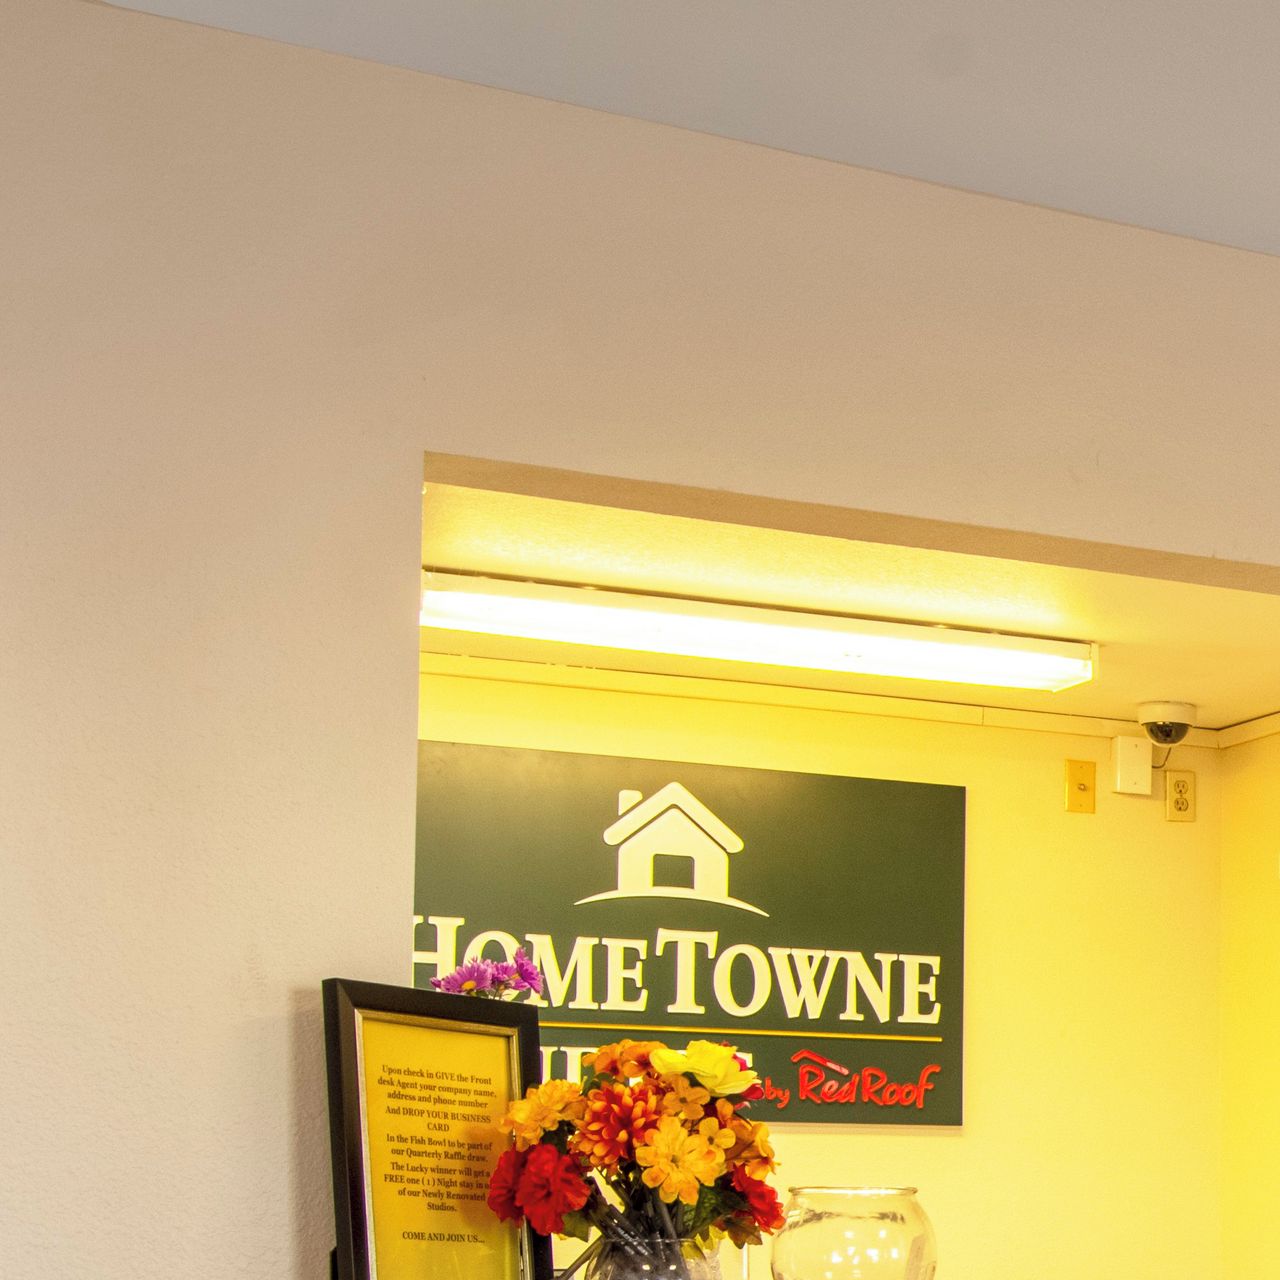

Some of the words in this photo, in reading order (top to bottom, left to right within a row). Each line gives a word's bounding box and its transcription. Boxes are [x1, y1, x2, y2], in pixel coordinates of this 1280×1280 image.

[382, 1065, 402, 1076] Upon
[404, 1068, 425, 1078] check
[426, 1070, 434, 1079] in
[435, 1072, 455, 1081] GIVE
[457, 1074, 469, 1083] the
[471, 1075, 492, 1085] Front
[377, 1077, 395, 1087] desk
[396, 1080, 418, 1090] Agent
[419, 1083, 436, 1093] your
[438, 1085, 472, 1097] company
[765, 1076, 790, 1109] by
[799, 1064, 860, 1104] Red
[862, 1064, 941, 1109] Roof
[387, 1092, 416, 1101] address
[418, 1094, 432, 1103] and
[433, 1096, 457, 1106] phone
[458, 1098, 488, 1109] number
[385, 1106, 401, 1115] And
[402, 1107, 426, 1118] DROP
[427, 1110, 450, 1121] YOUR
[451, 1113, 492, 1124] BUSINESS
[427, 1122, 450, 1132] CARD
[387, 1134, 395, 1143] In
[396, 1135, 409, 1144] the
[410, 1136, 426, 1146] Fish
[428, 1138, 446, 1148] Bowl
[448, 1140, 455, 1148] to
[457, 1140, 466, 1149] be
[468, 1142, 483, 1152] part
[484, 1142, 493, 1151] of
[391, 1147, 405, 1156] our
[406, 1149, 443, 1161] Quarterly
[444, 1151, 466, 1161] Raffle
[468, 1153, 489, 1163] draw.
[390, 1162, 405, 1171] The
[406, 1164, 429, 1175] Lucky
[430, 1166, 457, 1175] winner
[459, 1166, 473, 1177] will
[474, 1170, 485, 1179] get
[384, 1174, 405, 1183] FREE
[407, 1176, 420, 1185] one
[437, 1177, 458, 1189] Night
[459, 1180, 474, 1189] stay
[476, 1180, 484, 1188] in
[398, 1188, 406, 1197] of
[407, 1189, 421, 1198] our
[422, 1190, 445, 1201] Newly
[446, 1191, 486, 1201] Renovated
[427, 1202, 457, 1212] Studios.
[402, 1231, 426, 1241] COME
[427, 1232, 445, 1242] AND
[447, 1233, 466, 1243] JOIN
